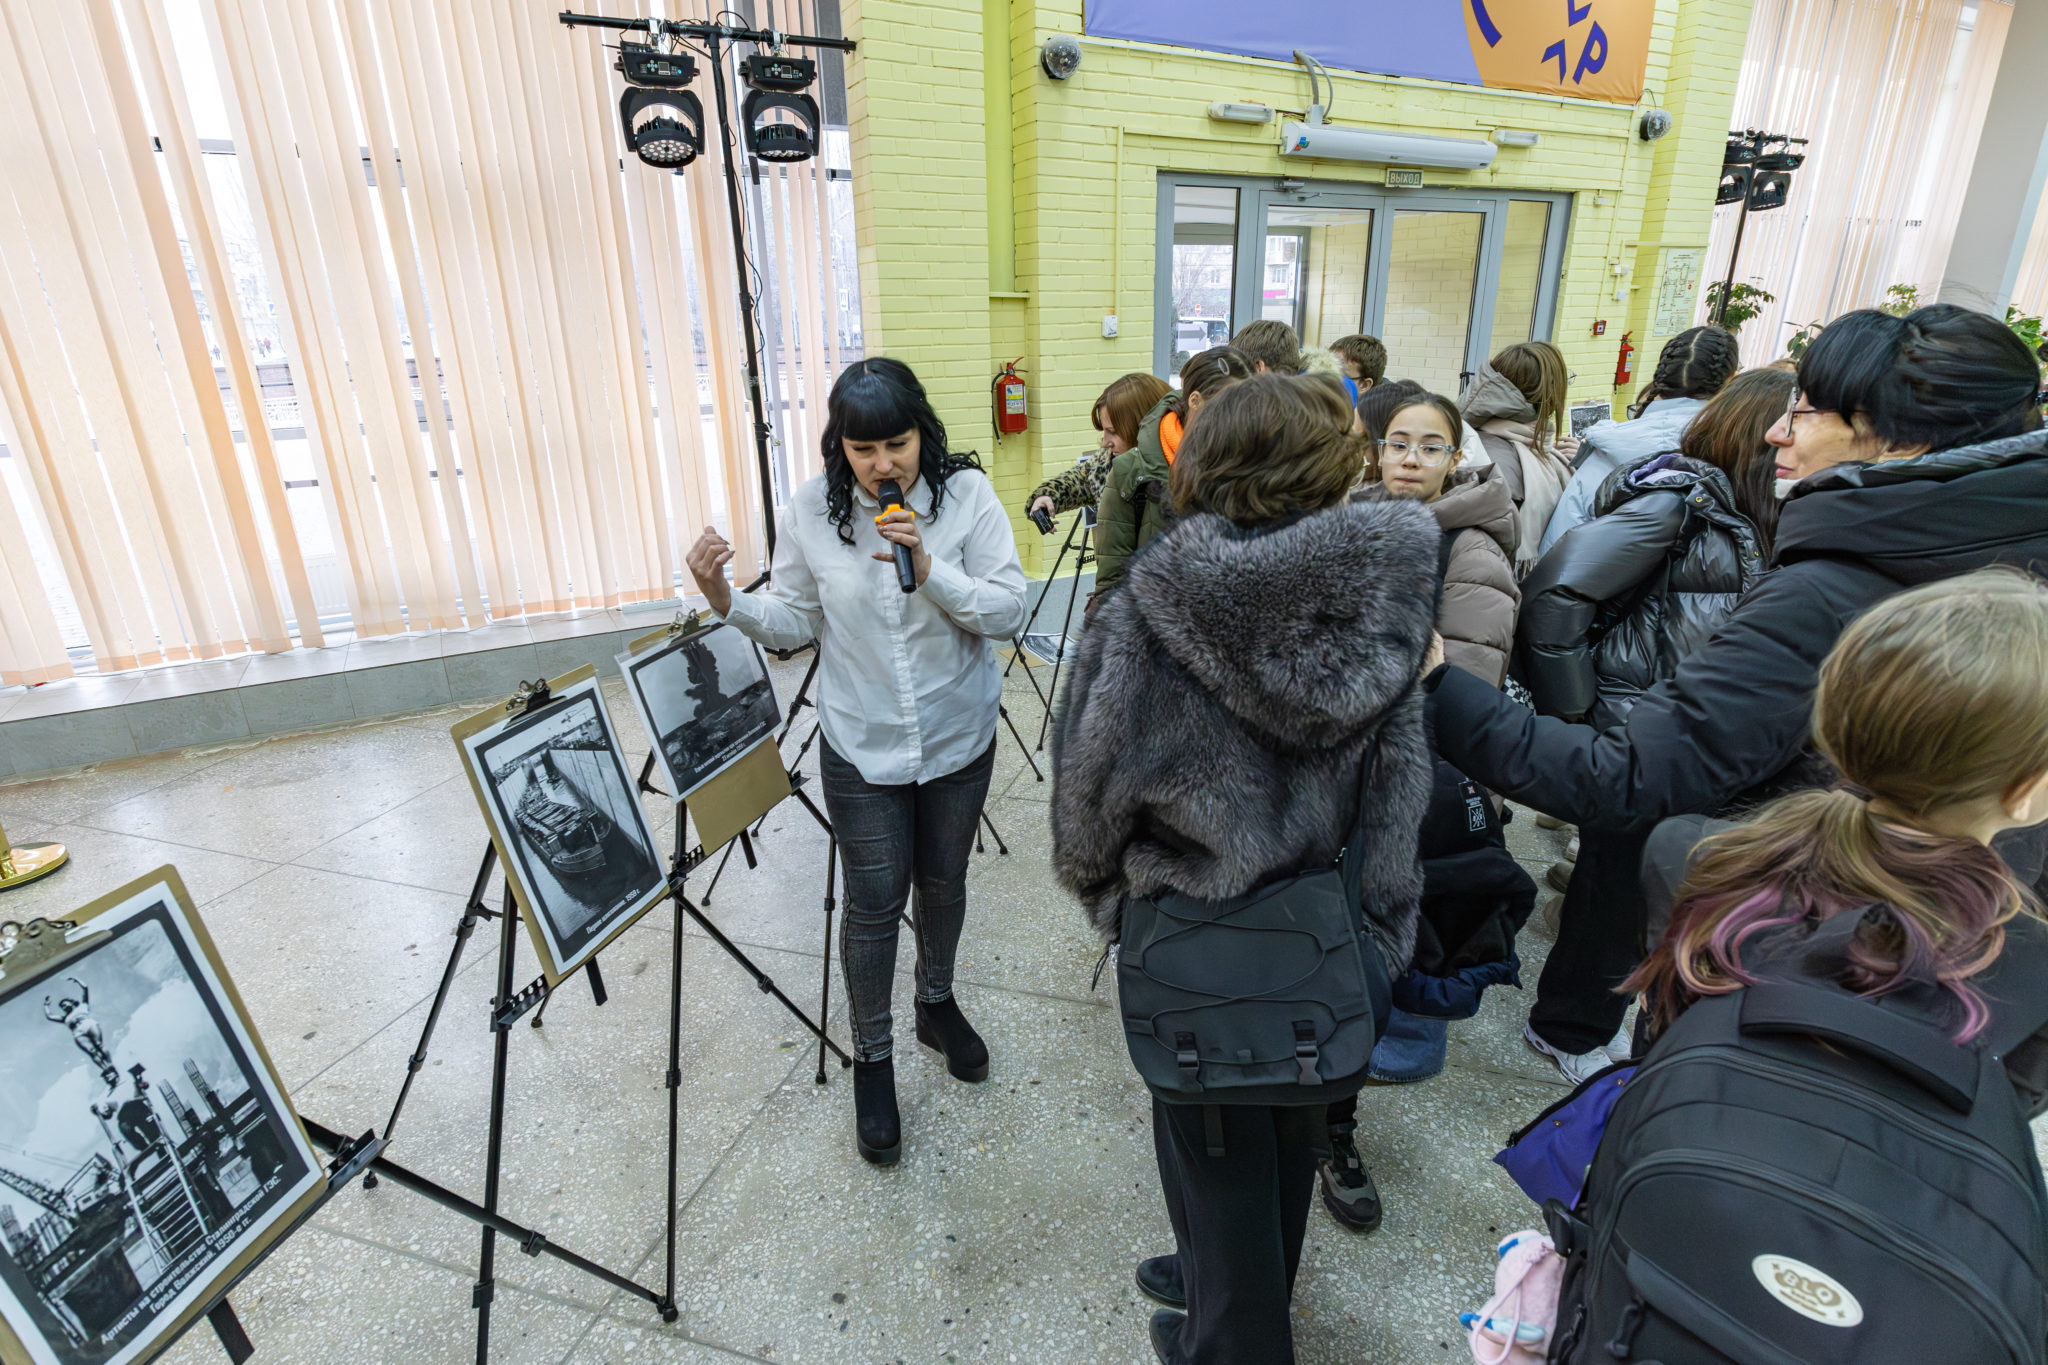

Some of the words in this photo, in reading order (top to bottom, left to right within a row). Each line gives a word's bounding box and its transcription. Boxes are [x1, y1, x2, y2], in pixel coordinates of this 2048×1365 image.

[1390, 172, 1420, 185] ВЫХОД
[101, 1306, 140, 1345] Артисты
[138, 1295, 151, 1310] на
[148, 1243, 207, 1298] строительстве
[204, 1188, 265, 1246] Сталинградской
[262, 1175, 281, 1193] ГЭС.
[148, 1287, 177, 1314] Город
[214, 1224, 243, 1251] 1950-е
[1783, 1270, 1835, 1305] BLO
